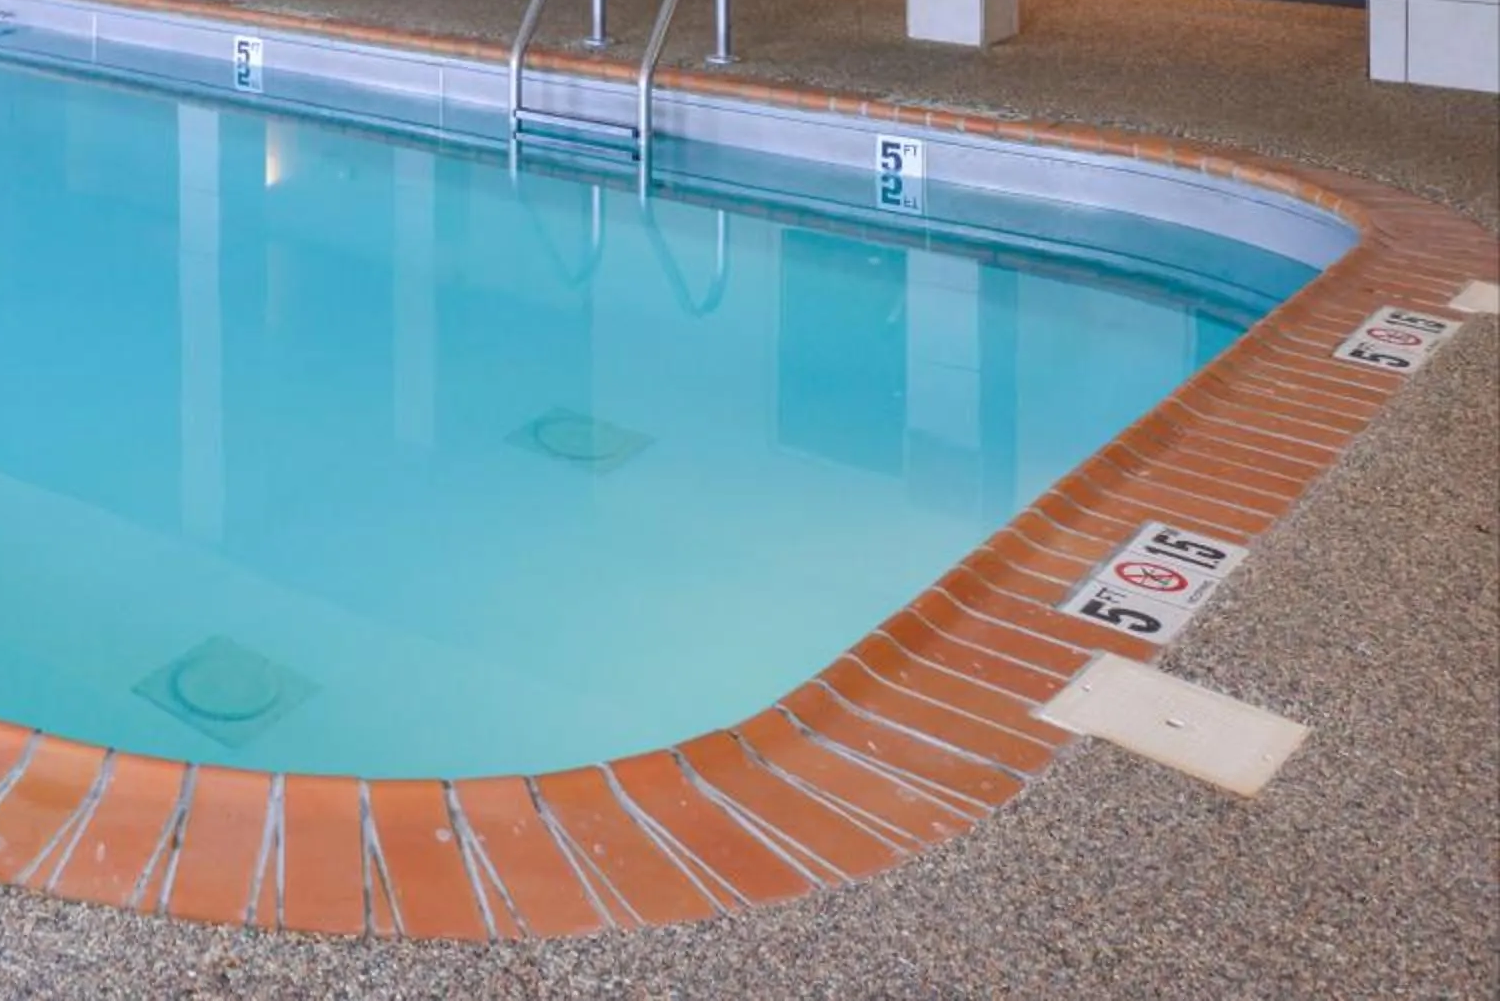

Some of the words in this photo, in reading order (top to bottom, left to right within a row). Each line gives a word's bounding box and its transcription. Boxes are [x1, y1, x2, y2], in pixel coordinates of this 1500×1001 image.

[237, 40, 250, 64] 5
[881, 141, 902, 172] 5
[903, 144, 918, 157] FT
[1348, 349, 1410, 368] 5
[1095, 587, 1127, 604] FT
[1079, 598, 1162, 633] 5
